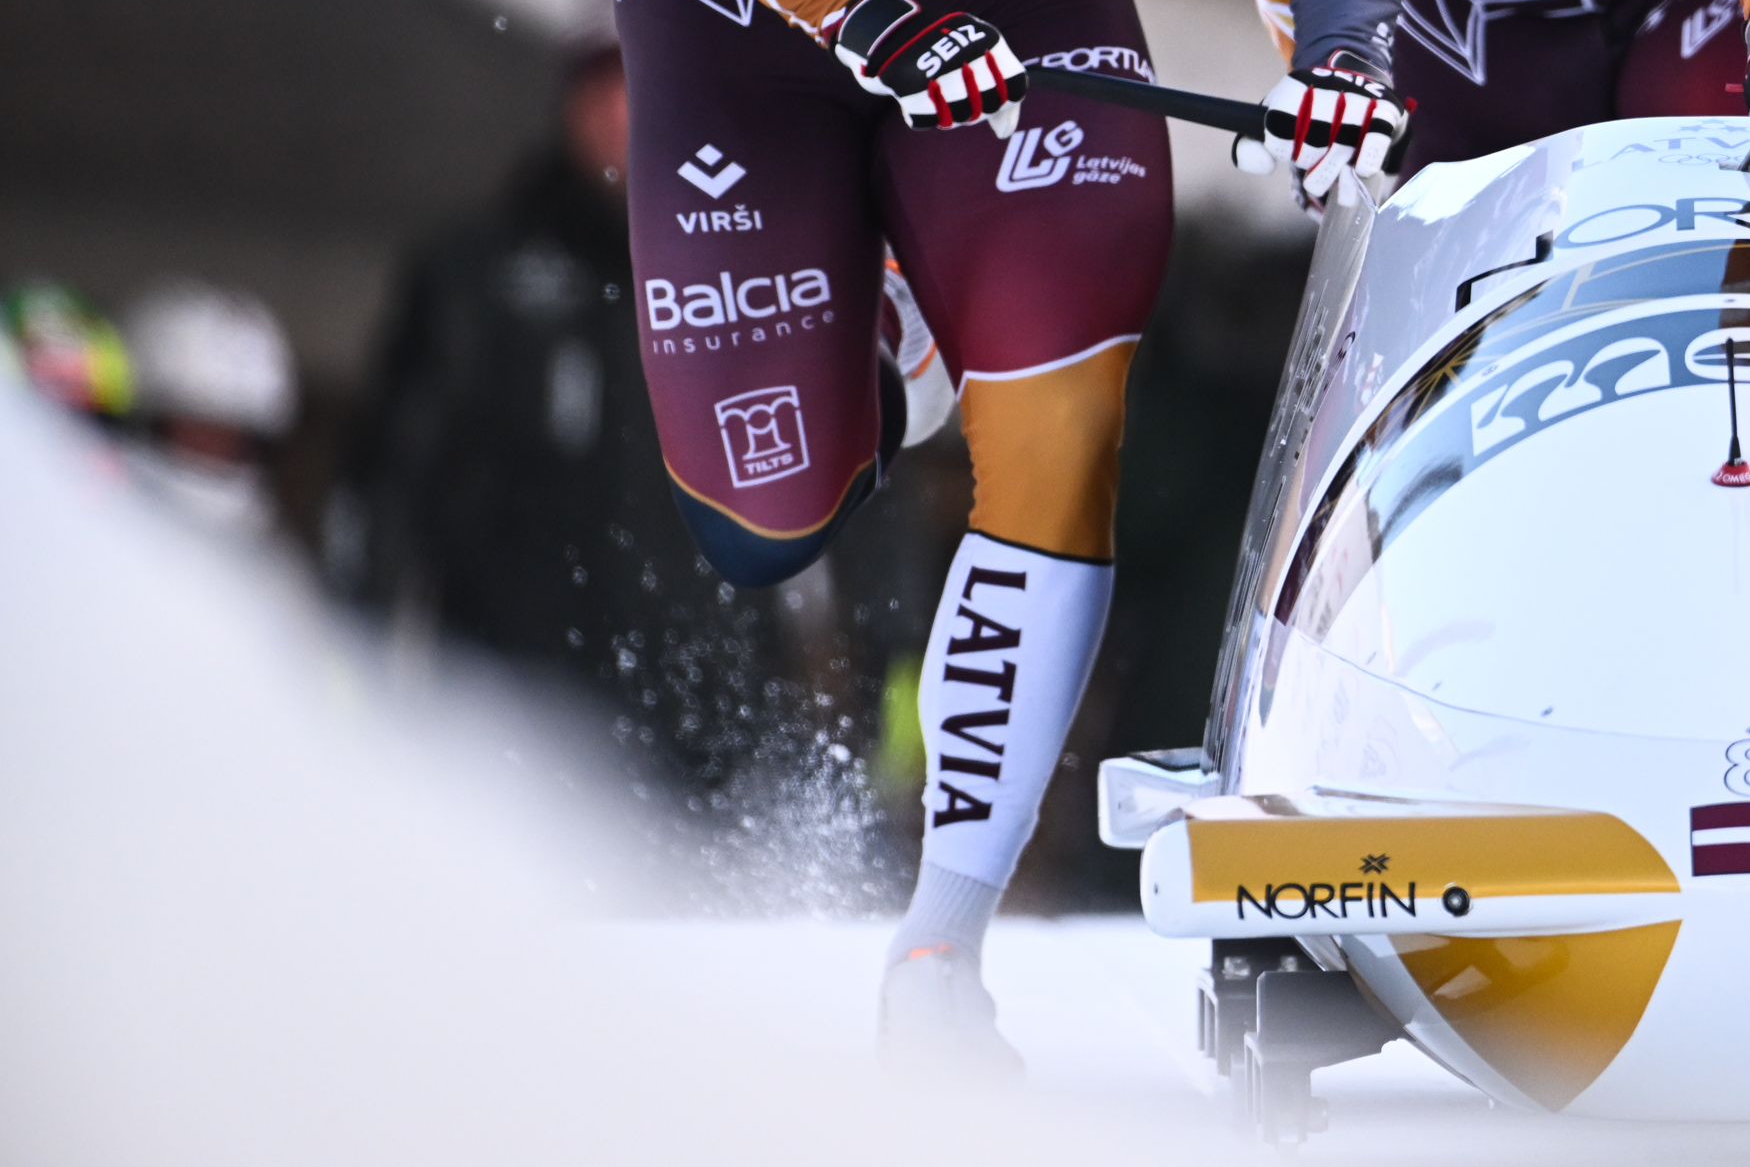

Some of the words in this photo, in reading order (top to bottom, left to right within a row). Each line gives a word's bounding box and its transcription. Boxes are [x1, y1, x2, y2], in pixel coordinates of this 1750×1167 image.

[676, 203, 763, 235] VIRŠI
[645, 267, 832, 331] Balcia
[652, 309, 835, 355] insurance
[744, 452, 795, 475] TILTS
[933, 565, 1028, 829] LATVIA
[1235, 880, 1417, 920] NORFIN
